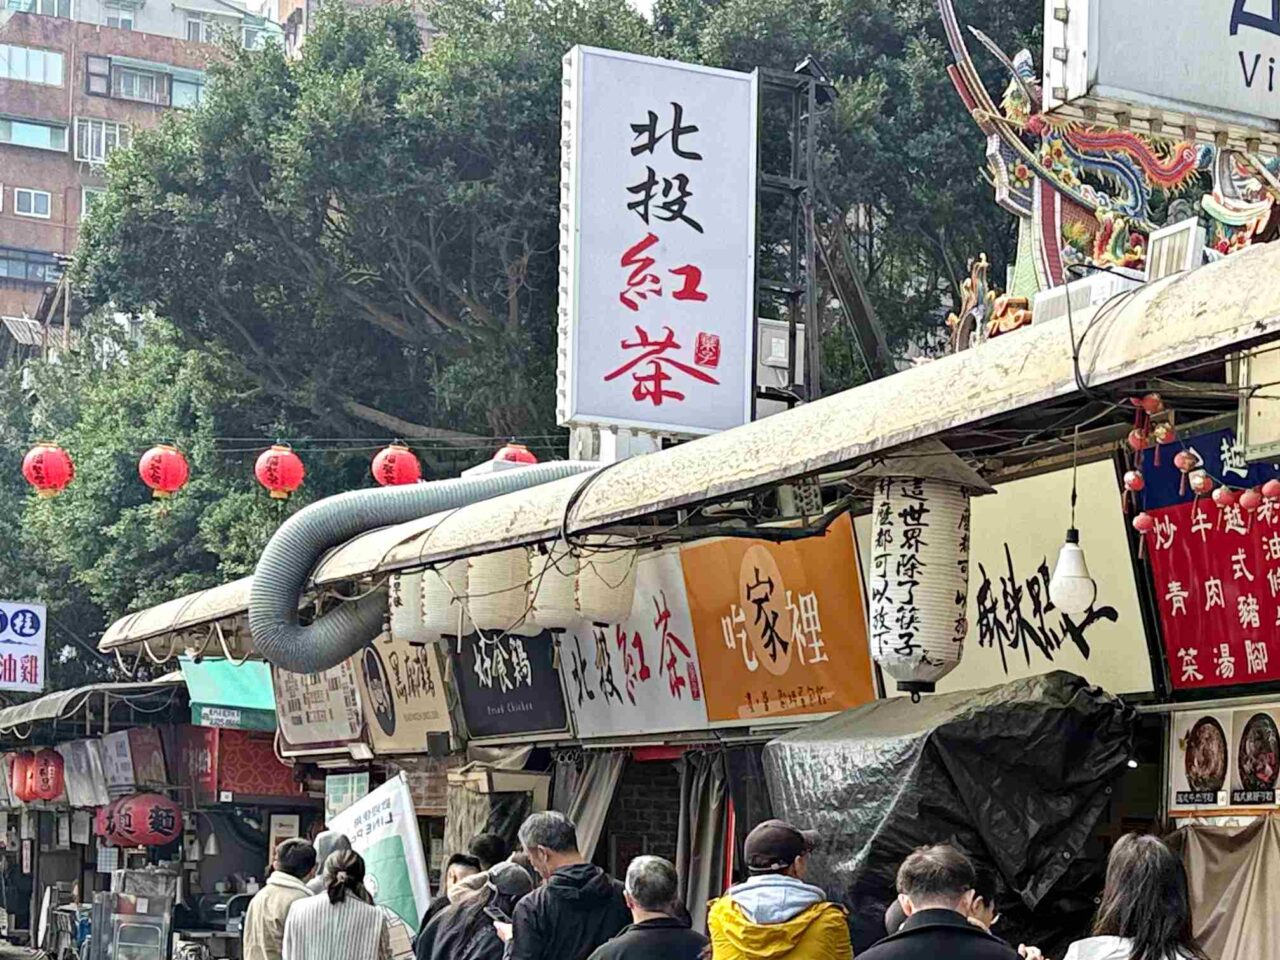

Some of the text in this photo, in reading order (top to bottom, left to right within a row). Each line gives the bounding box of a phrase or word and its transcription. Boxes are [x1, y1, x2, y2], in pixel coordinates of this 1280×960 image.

[604, 102, 720, 406] 北投紅茶
[571, 589, 692, 708] 北投紅茶
[721, 566, 829, 672] 吃家裡
[1153, 514, 1204, 682] 炒青菜
[1191, 508, 1236, 679] 牛肉湯
